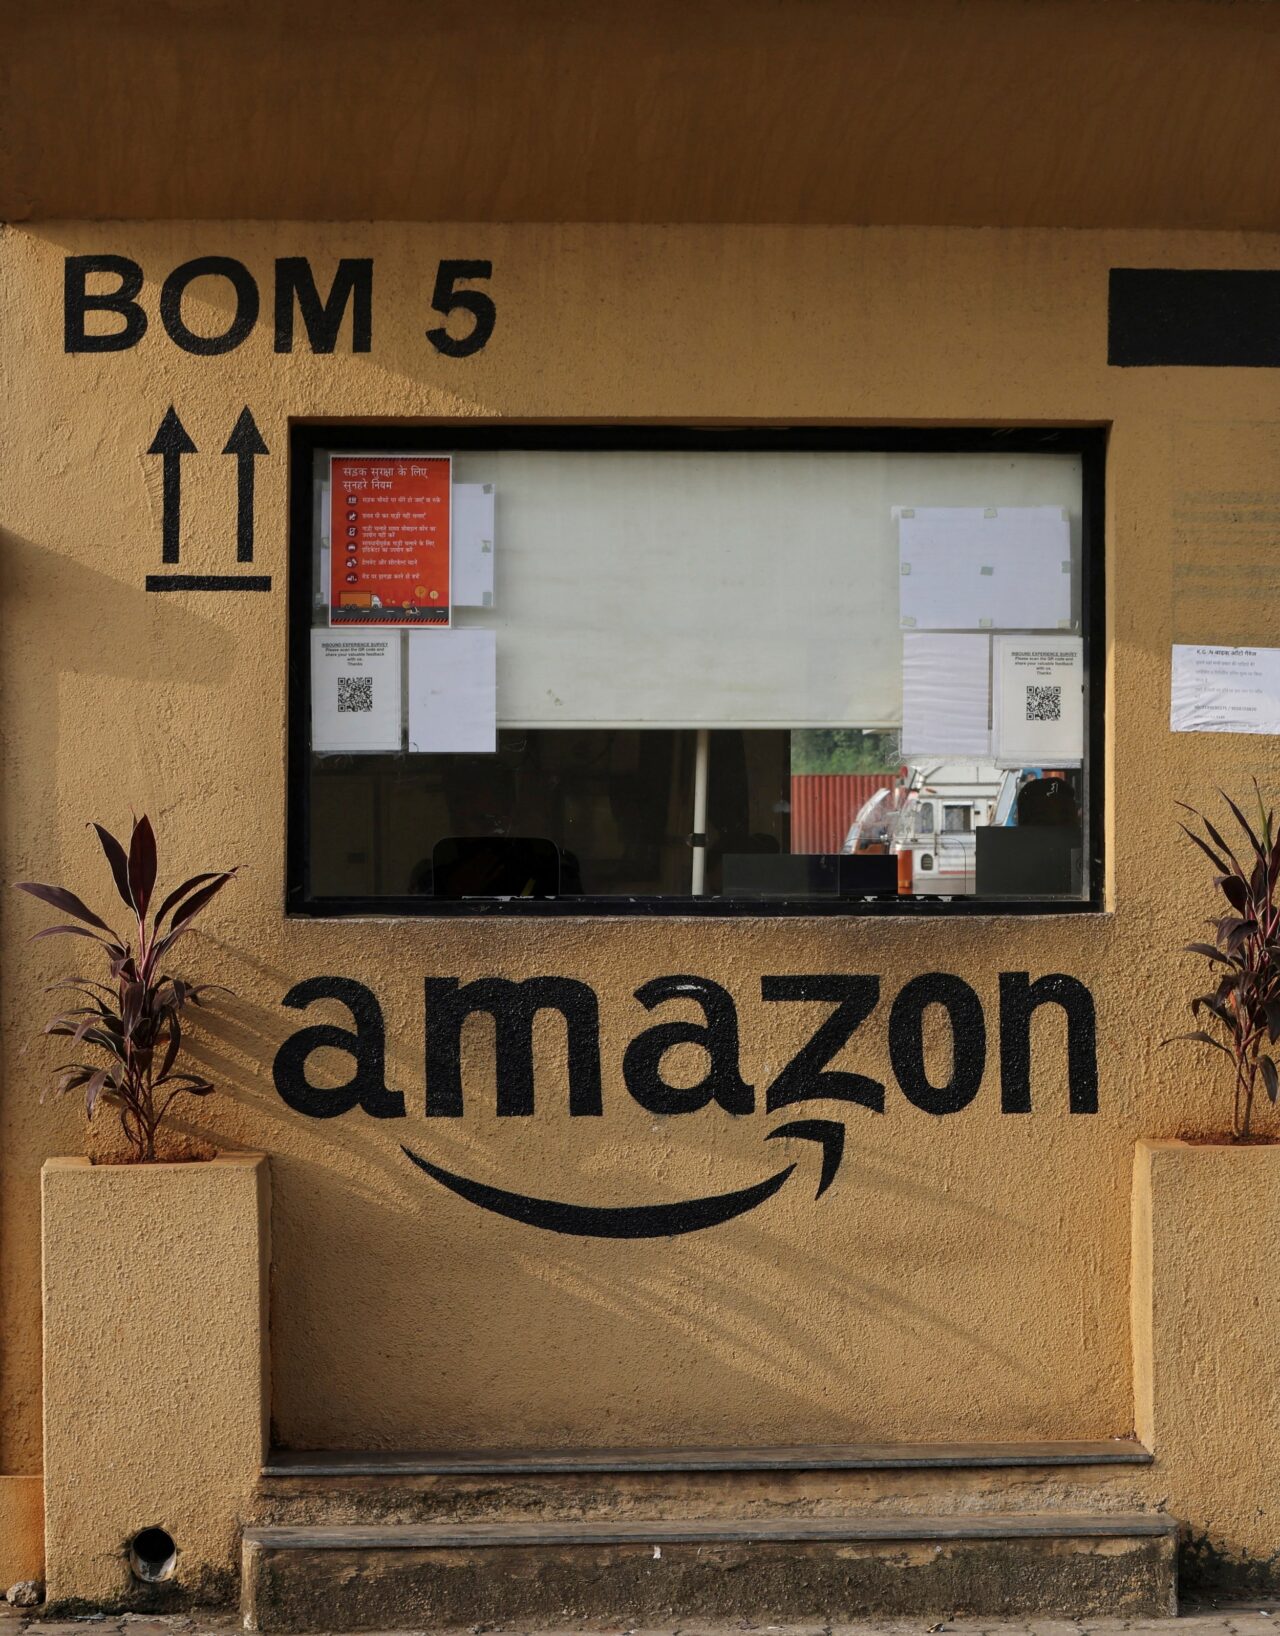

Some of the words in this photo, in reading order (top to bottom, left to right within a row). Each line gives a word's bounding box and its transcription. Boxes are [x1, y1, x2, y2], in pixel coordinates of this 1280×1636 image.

[63, 254, 375, 357] BOM
[424, 259, 498, 359] 5
[271, 971, 1101, 1120] amazon
